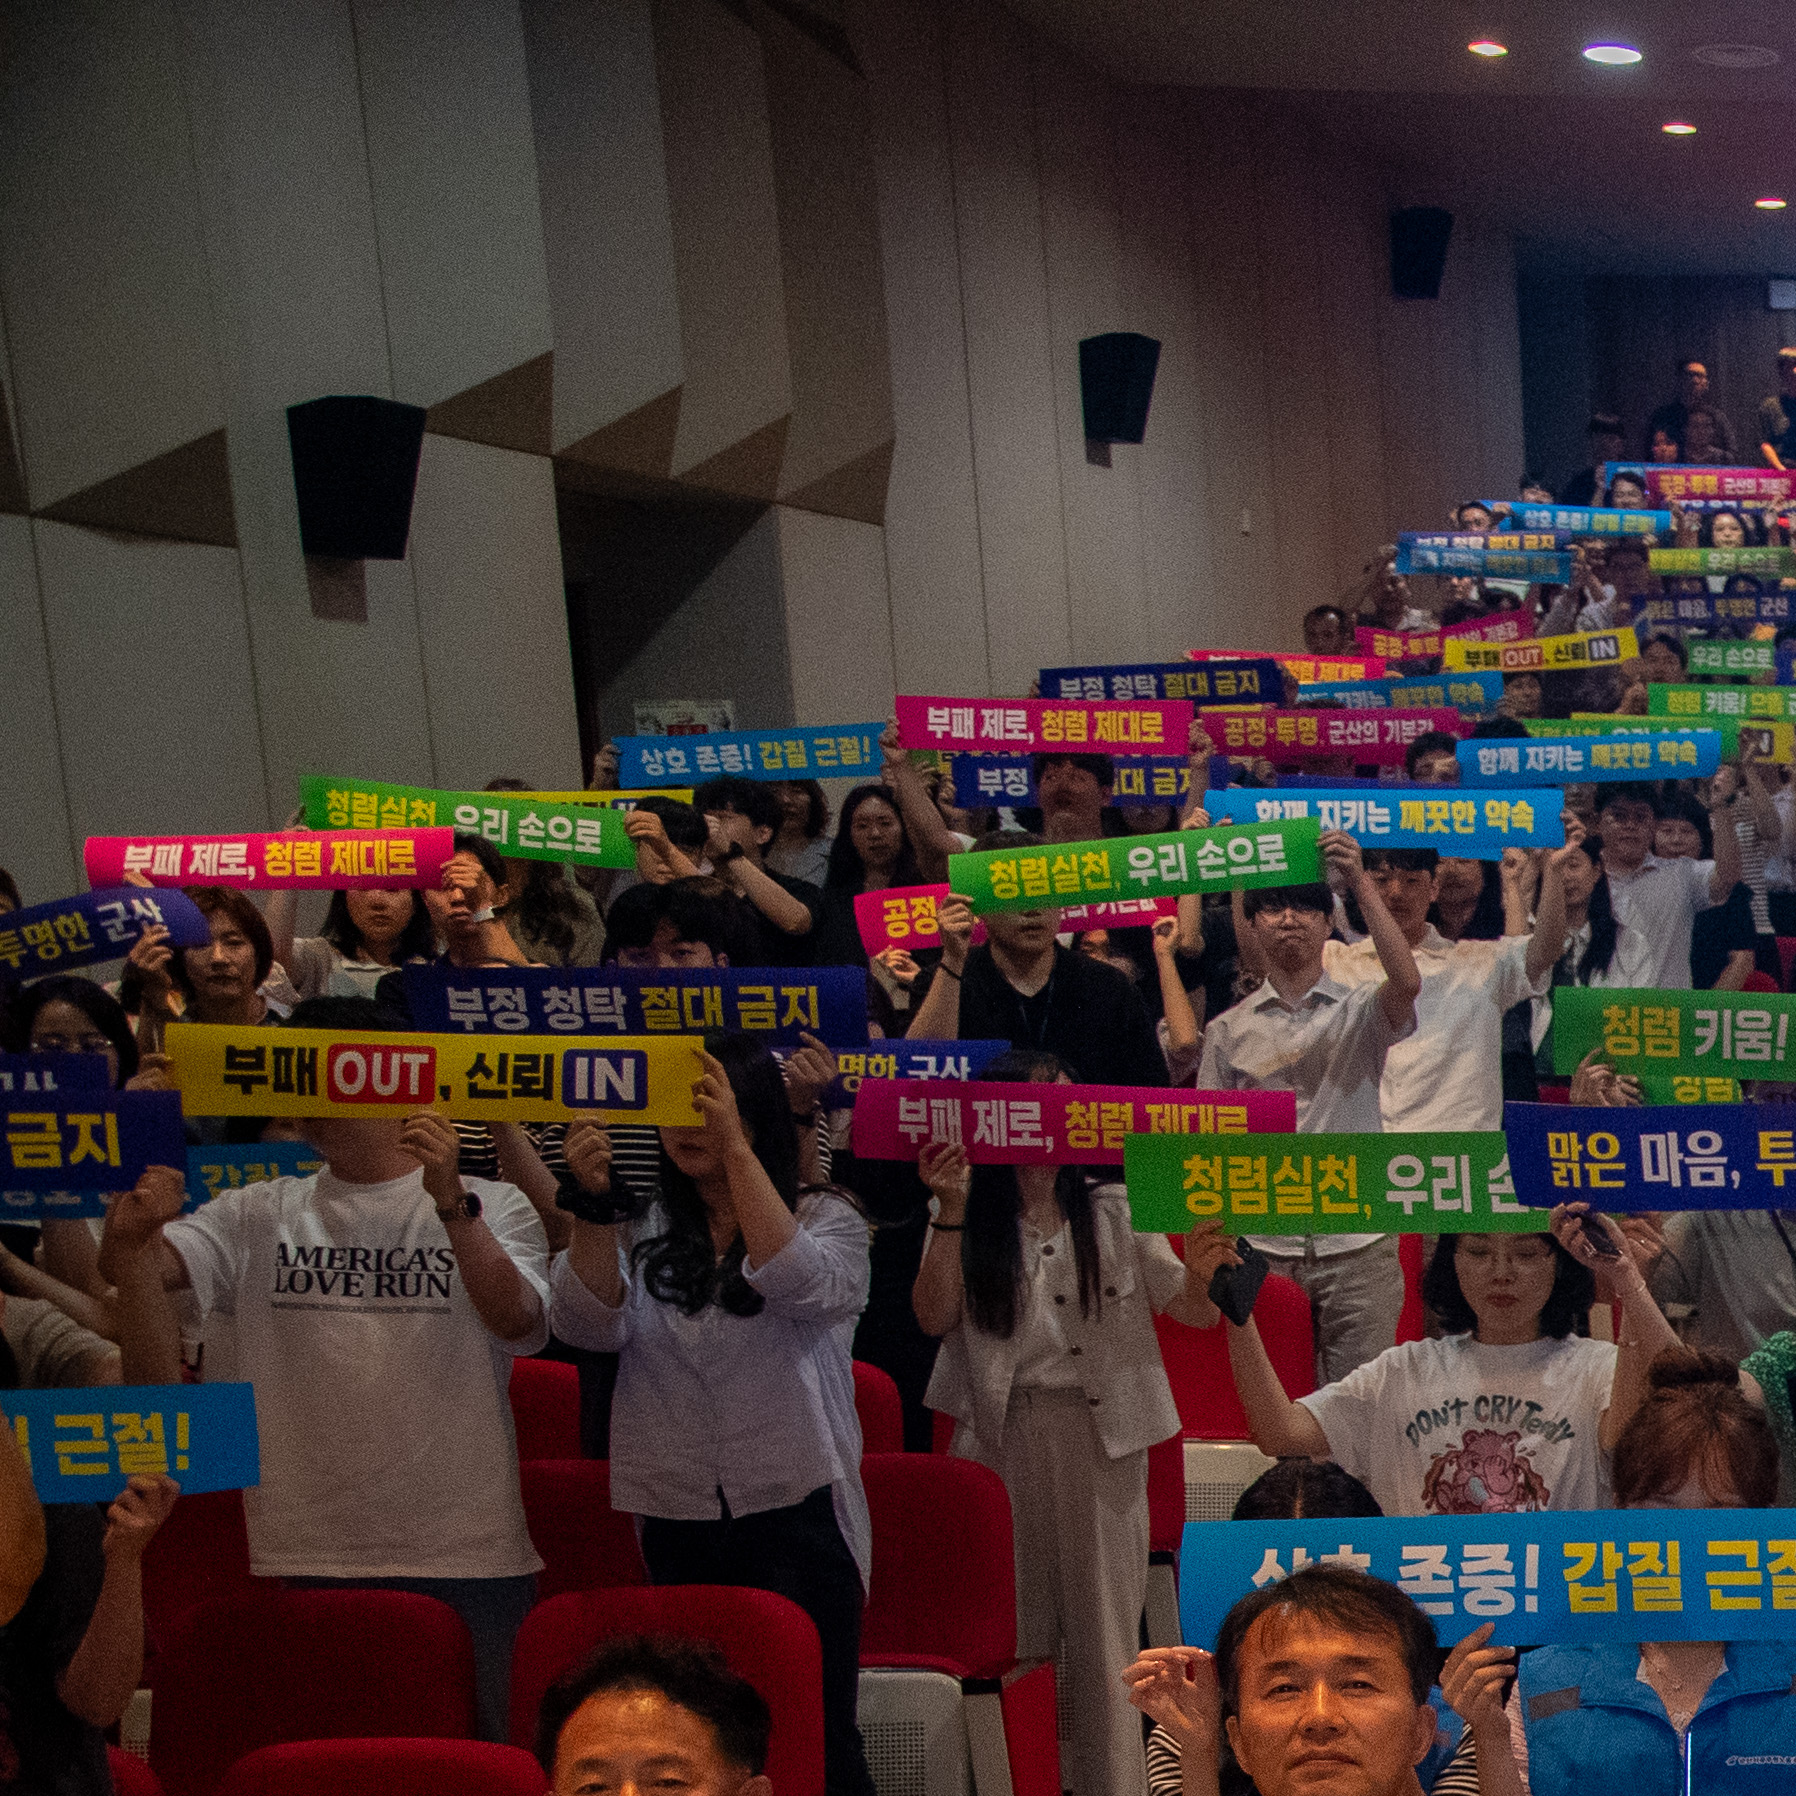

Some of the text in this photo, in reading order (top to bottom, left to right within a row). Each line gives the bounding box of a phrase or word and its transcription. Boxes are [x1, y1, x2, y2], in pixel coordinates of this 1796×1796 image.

[1163, 669, 1260, 698] 절대 금지
[927, 706, 1164, 745] 부패 제로, 청렴 제대로
[1329, 719, 1378, 746] 군산의
[640, 738, 871, 777] 상호 존중! 갑질 근절!
[1477, 738, 1697, 775] 함께 지키는 깨끗한 약속
[976, 765, 1029, 799] 부정
[517, 811, 601, 855] 손으로
[1399, 799, 1535, 834] 깨끗한 약속
[122, 838, 417, 878] 부패 청렴 제대로
[1126, 833, 1289, 885] 우리 손으로
[447, 984, 821, 1032] 부정 청탁 절대 금지
[1602, 1005, 1681, 1058] 청렴
[1693, 1008, 1788, 1061] 키움!
[223, 1046, 318, 1096] 부패
[465, 1051, 554, 1101] 신뢰
[574, 1056, 638, 1102] IN
[6, 1110, 123, 1170] 금지
[972, 1098, 1135, 1154] 제로, 청렴
[1547, 1130, 1627, 1190] 맑은
[1638, 1128, 1742, 1190] 마음,
[1182, 1152, 1473, 1220] 청렴실천, 우리
[275, 1242, 455, 1274] AMERICA'S
[274, 1268, 452, 1299] LOVE RUN
[1473, 1394, 1522, 1424] CRY
[53, 1411, 191, 1477] 근절!
[1397, 1541, 1540, 1618] 존중!
[1561, 1539, 1685, 1614] 갑질
